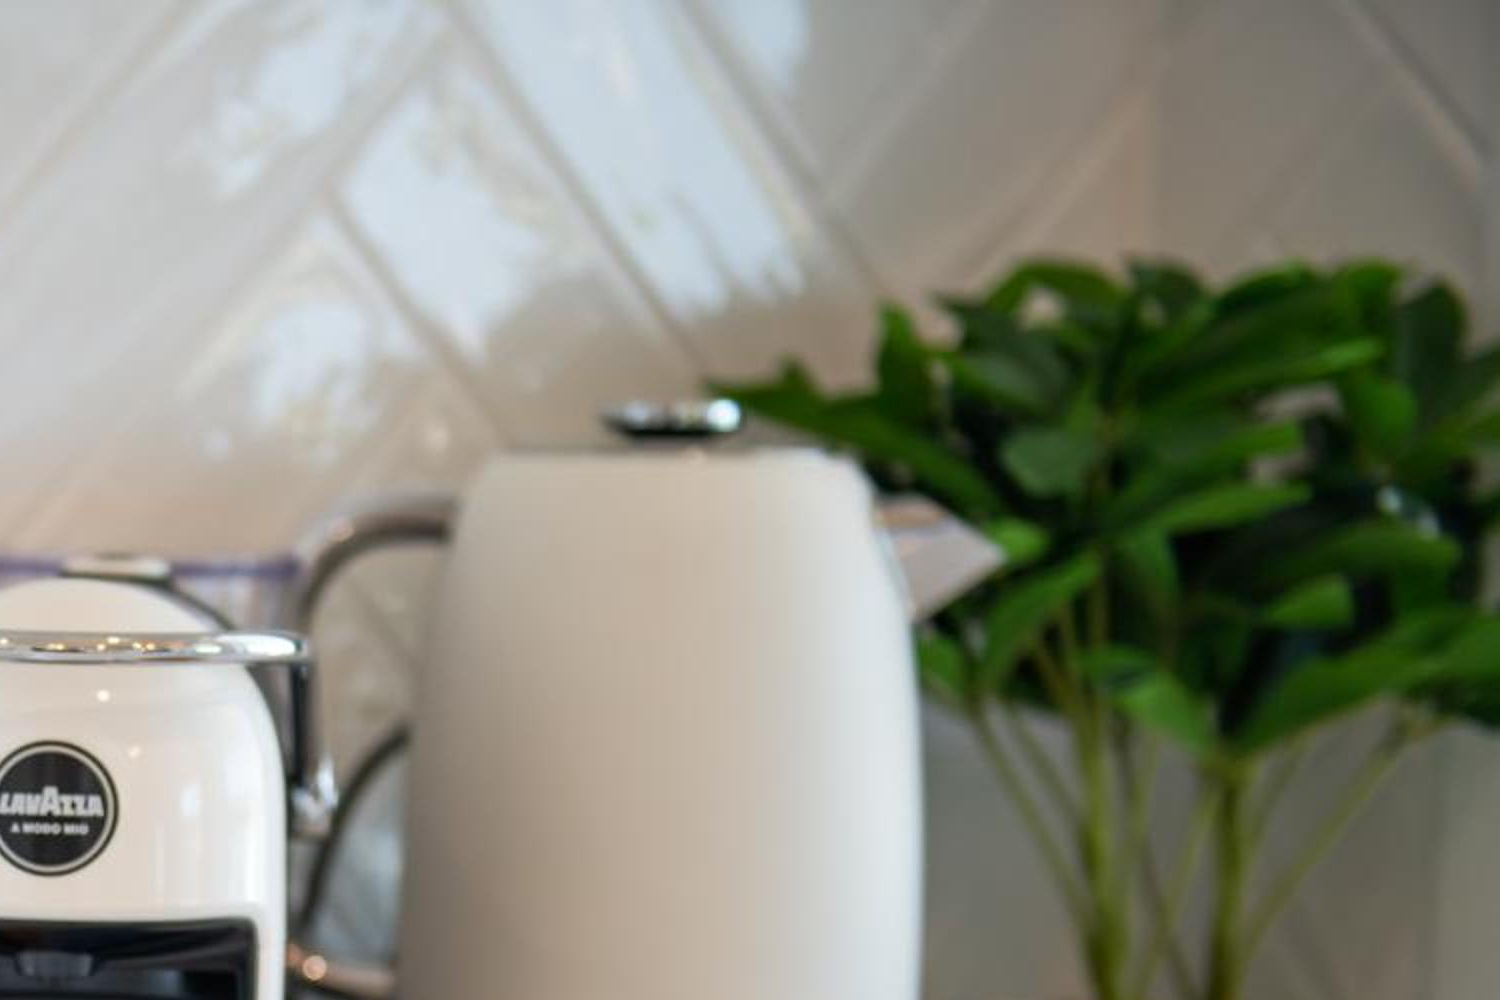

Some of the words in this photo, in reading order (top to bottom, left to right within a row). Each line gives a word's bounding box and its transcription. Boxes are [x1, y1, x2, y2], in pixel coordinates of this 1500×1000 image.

[11, 823, 20, 833] A
[23, 823, 61, 834] MODO
[64, 823, 89, 835] MIO
